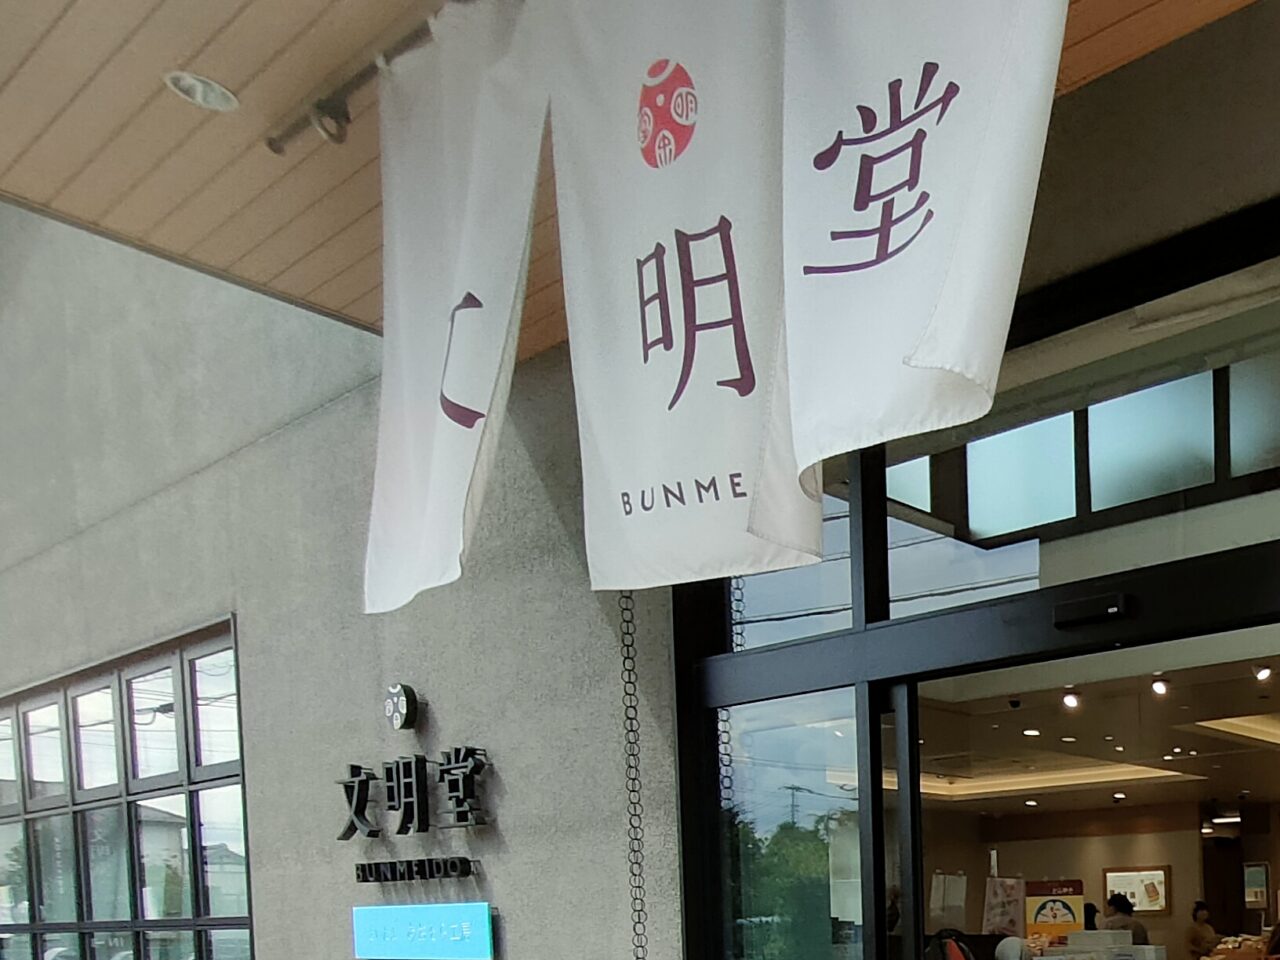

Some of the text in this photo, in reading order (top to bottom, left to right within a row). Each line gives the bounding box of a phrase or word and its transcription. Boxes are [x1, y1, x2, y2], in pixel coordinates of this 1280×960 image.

[620, 472, 748, 516] BUNME
[335, 746, 488, 840] 文明堂
[355, 857, 473, 883] BUNMEIDO
